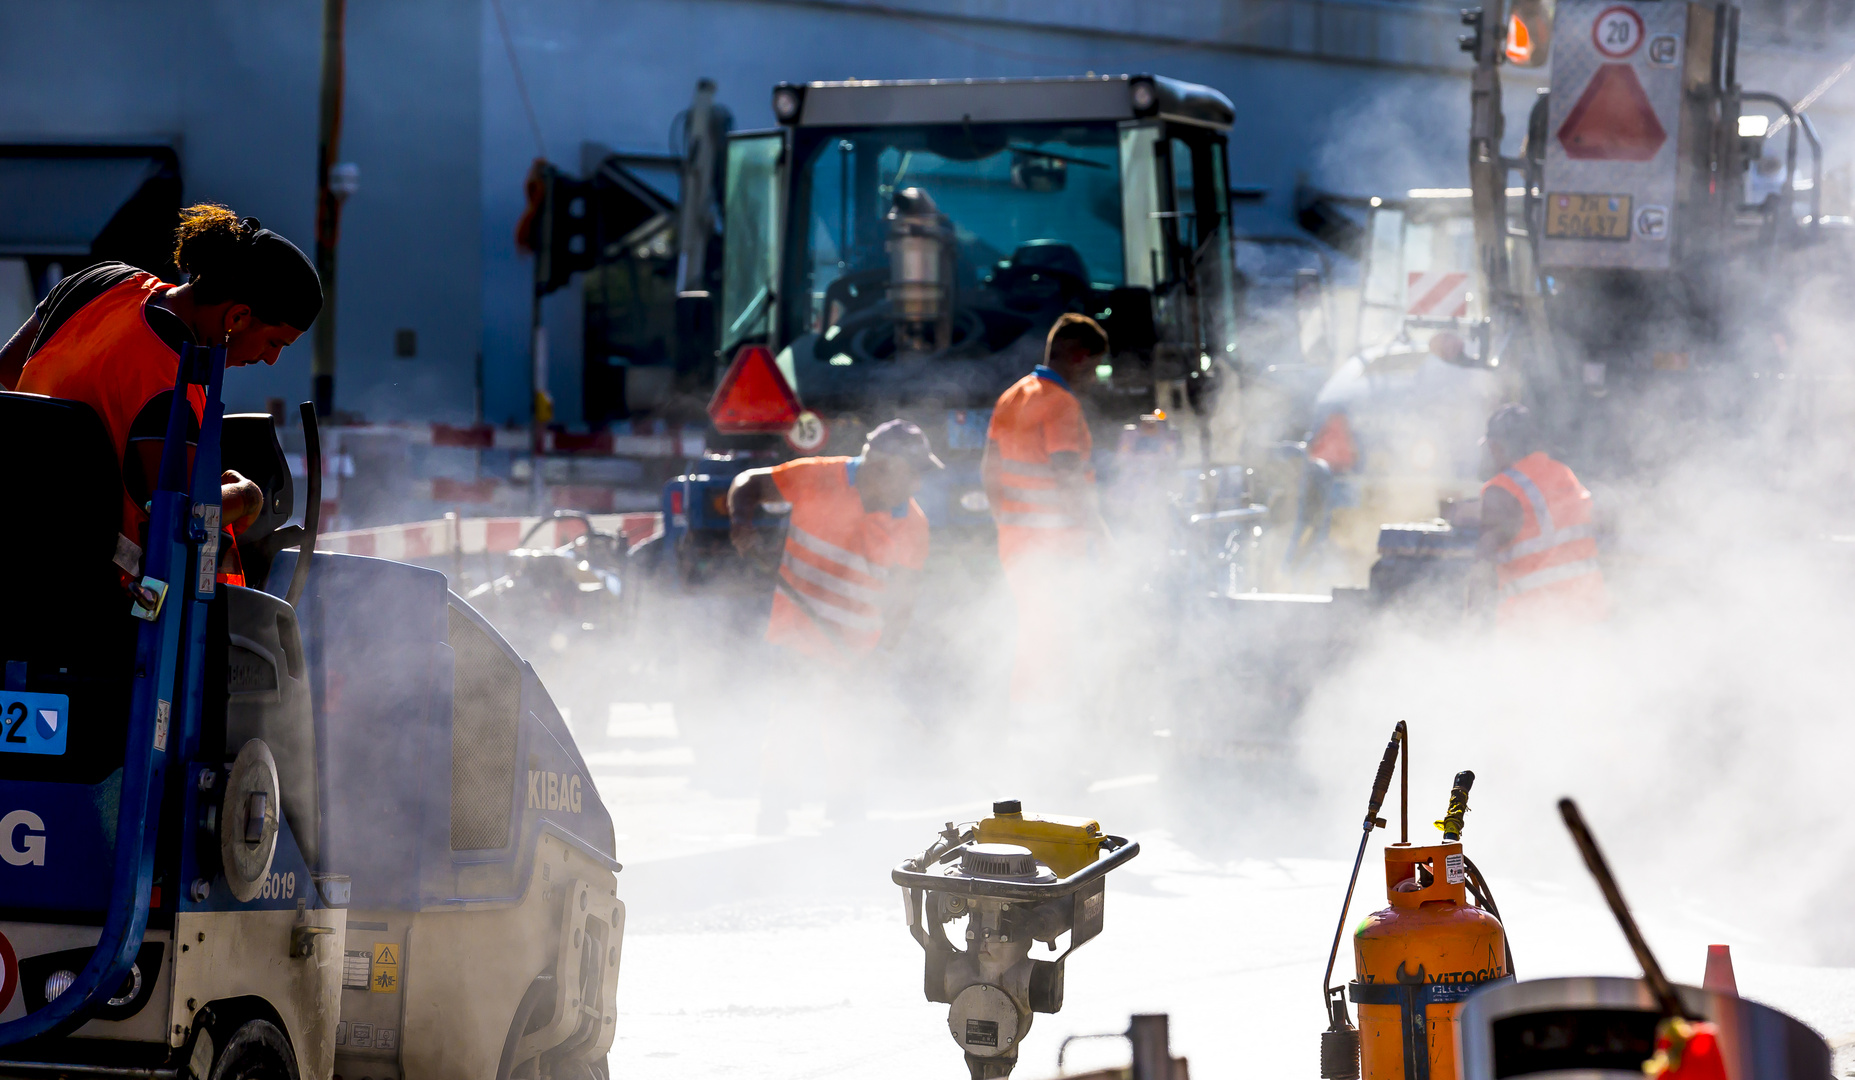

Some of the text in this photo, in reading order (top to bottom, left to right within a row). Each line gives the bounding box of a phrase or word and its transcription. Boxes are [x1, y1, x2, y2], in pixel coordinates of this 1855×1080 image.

[1607, 20, 1630, 44] 20
[0, 701, 28, 743] 2
[528, 770, 582, 813] KIBAG
[255, 872, 296, 900] 6019
